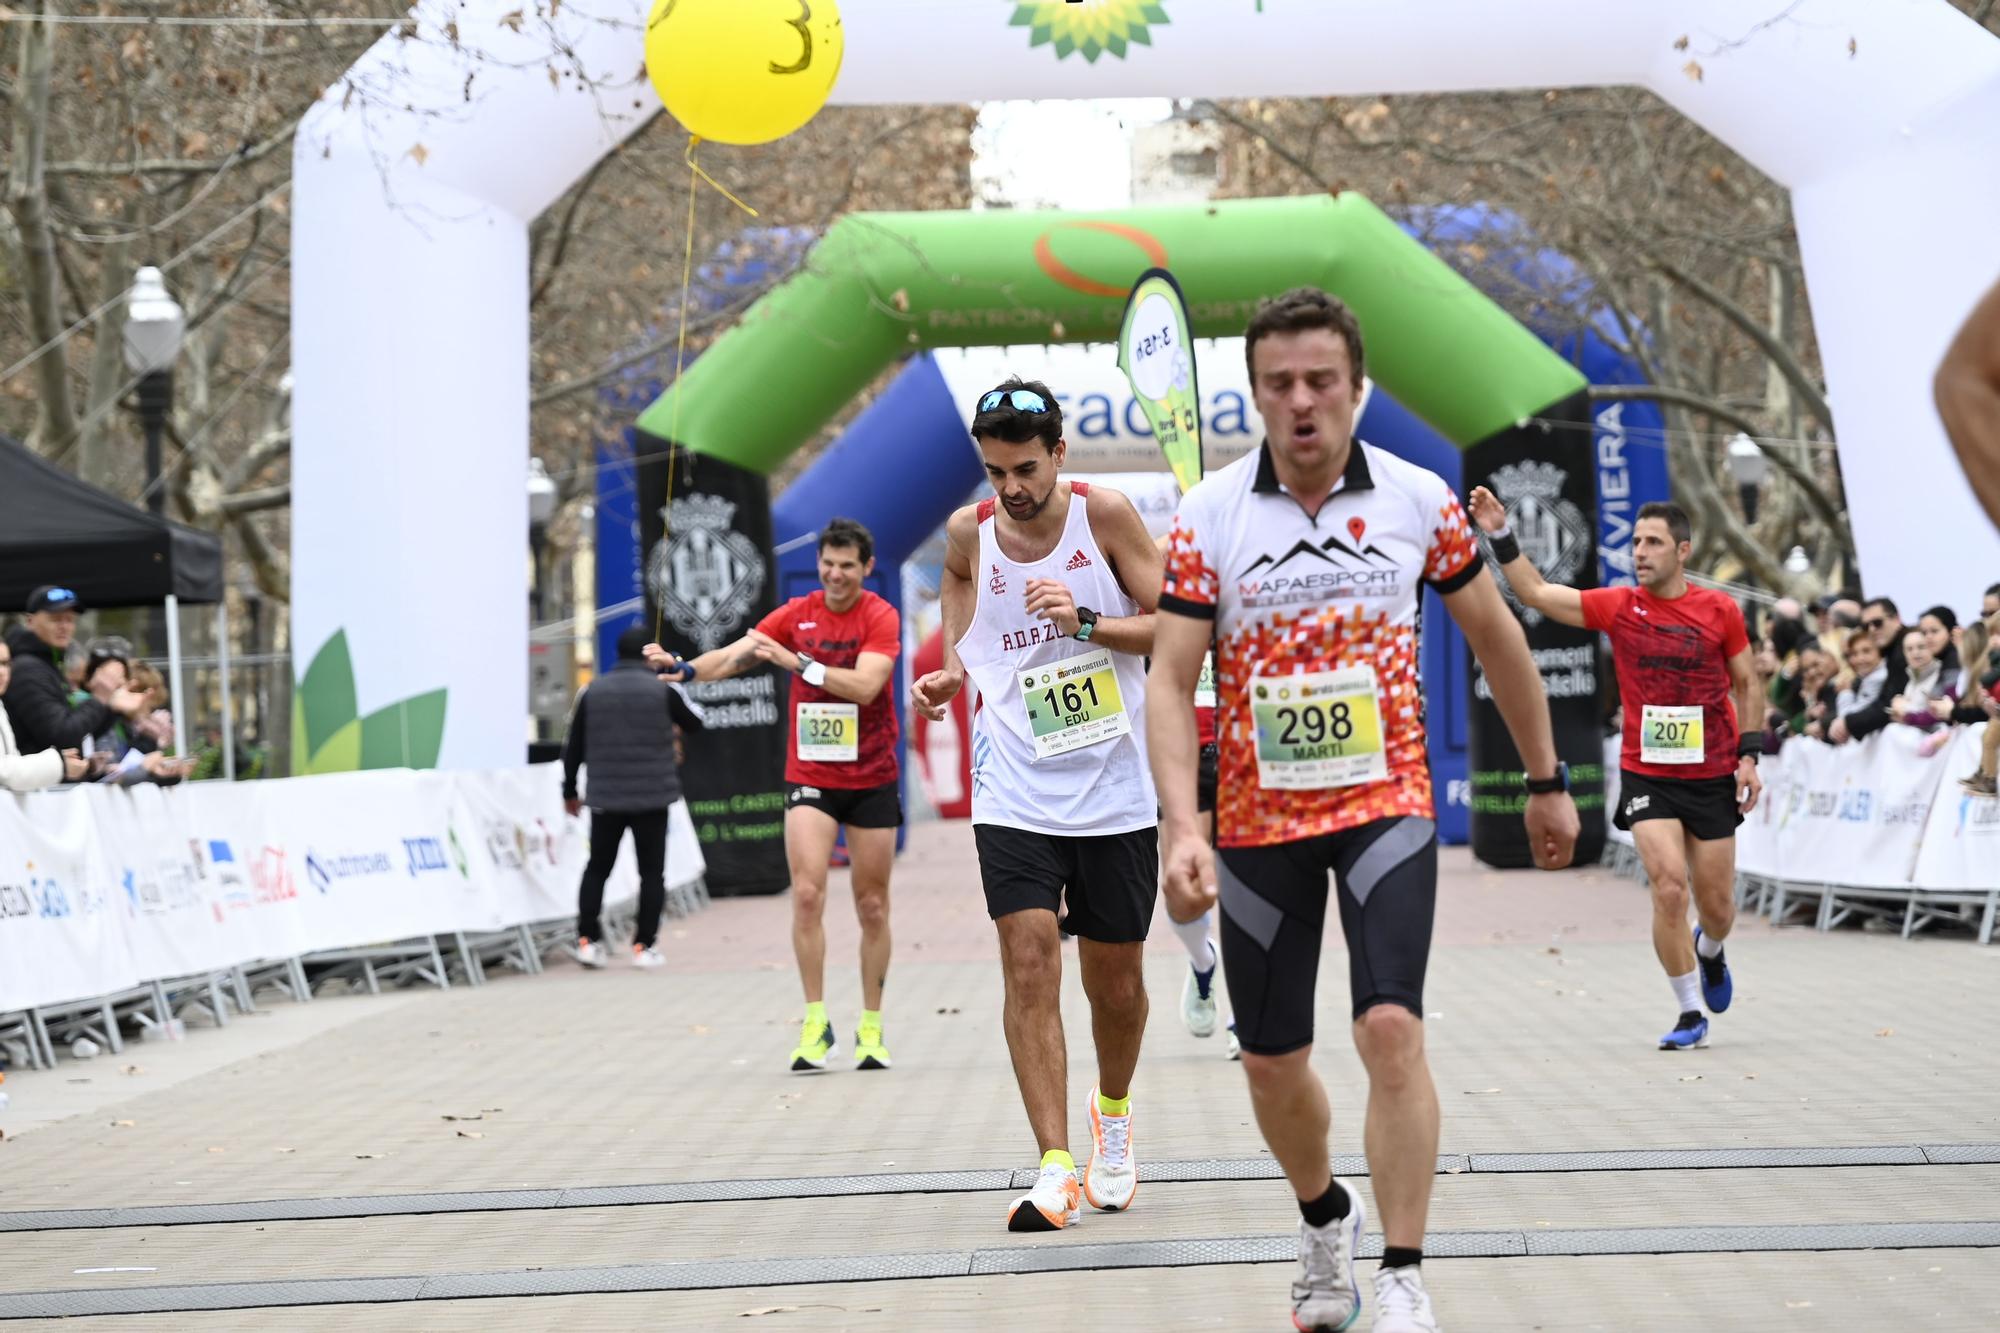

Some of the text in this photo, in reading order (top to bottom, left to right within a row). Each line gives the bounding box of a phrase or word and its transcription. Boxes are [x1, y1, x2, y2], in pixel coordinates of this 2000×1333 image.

[1066, 559, 1092, 571] adidas
[1238, 569, 1399, 595] MAPAESPORT
[1044, 677, 1099, 718] 161
[809, 718, 844, 738] 320
[1064, 711, 1090, 727] EDU
[1276, 701, 1352, 745] 298
[1654, 721, 1689, 740] 207
